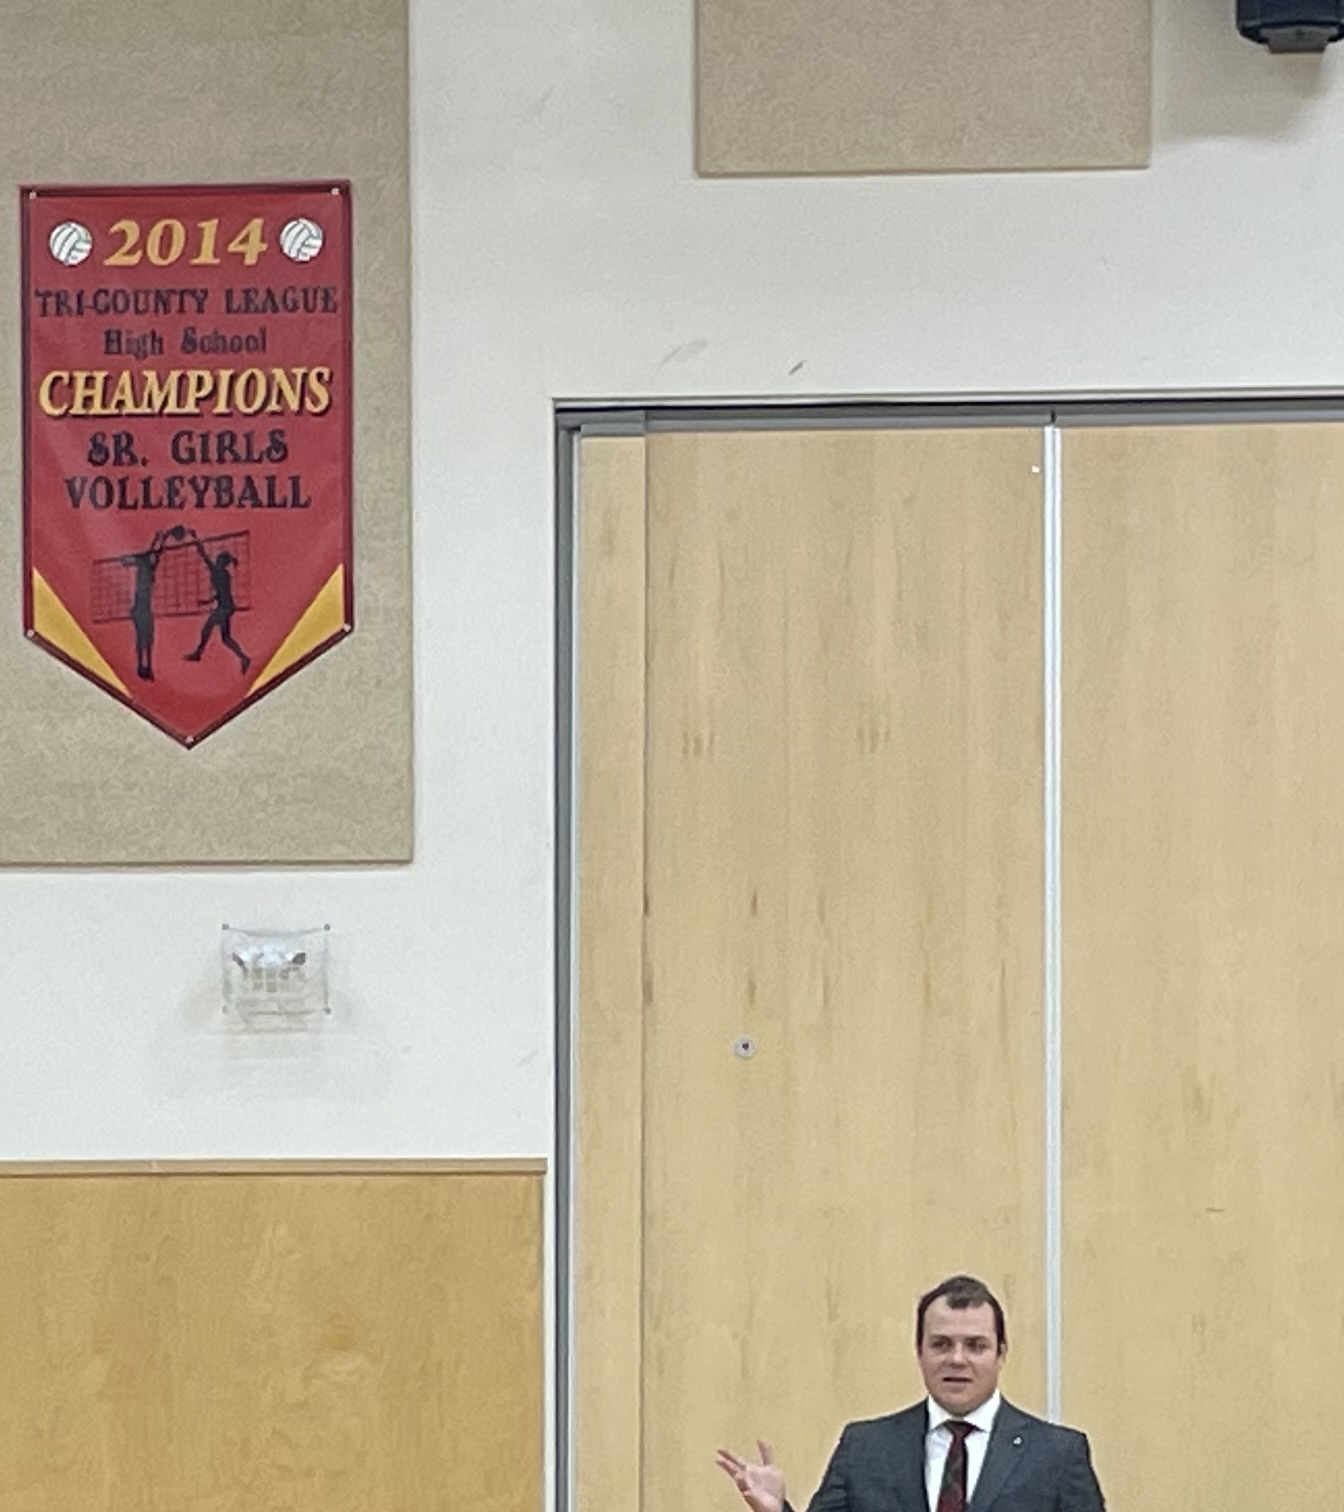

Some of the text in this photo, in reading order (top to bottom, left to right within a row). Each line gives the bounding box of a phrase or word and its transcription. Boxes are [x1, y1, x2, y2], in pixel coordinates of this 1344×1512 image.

[103, 217, 269, 266] 2014
[35, 285, 339, 317] TRI-COUNTY LEAGUE
[103, 326, 268, 360] High School
[39, 366, 334, 419] CHAMPIONS
[87, 429, 289, 468] SR. GIRLS
[65, 474, 312, 511] VOLLEYBALL
